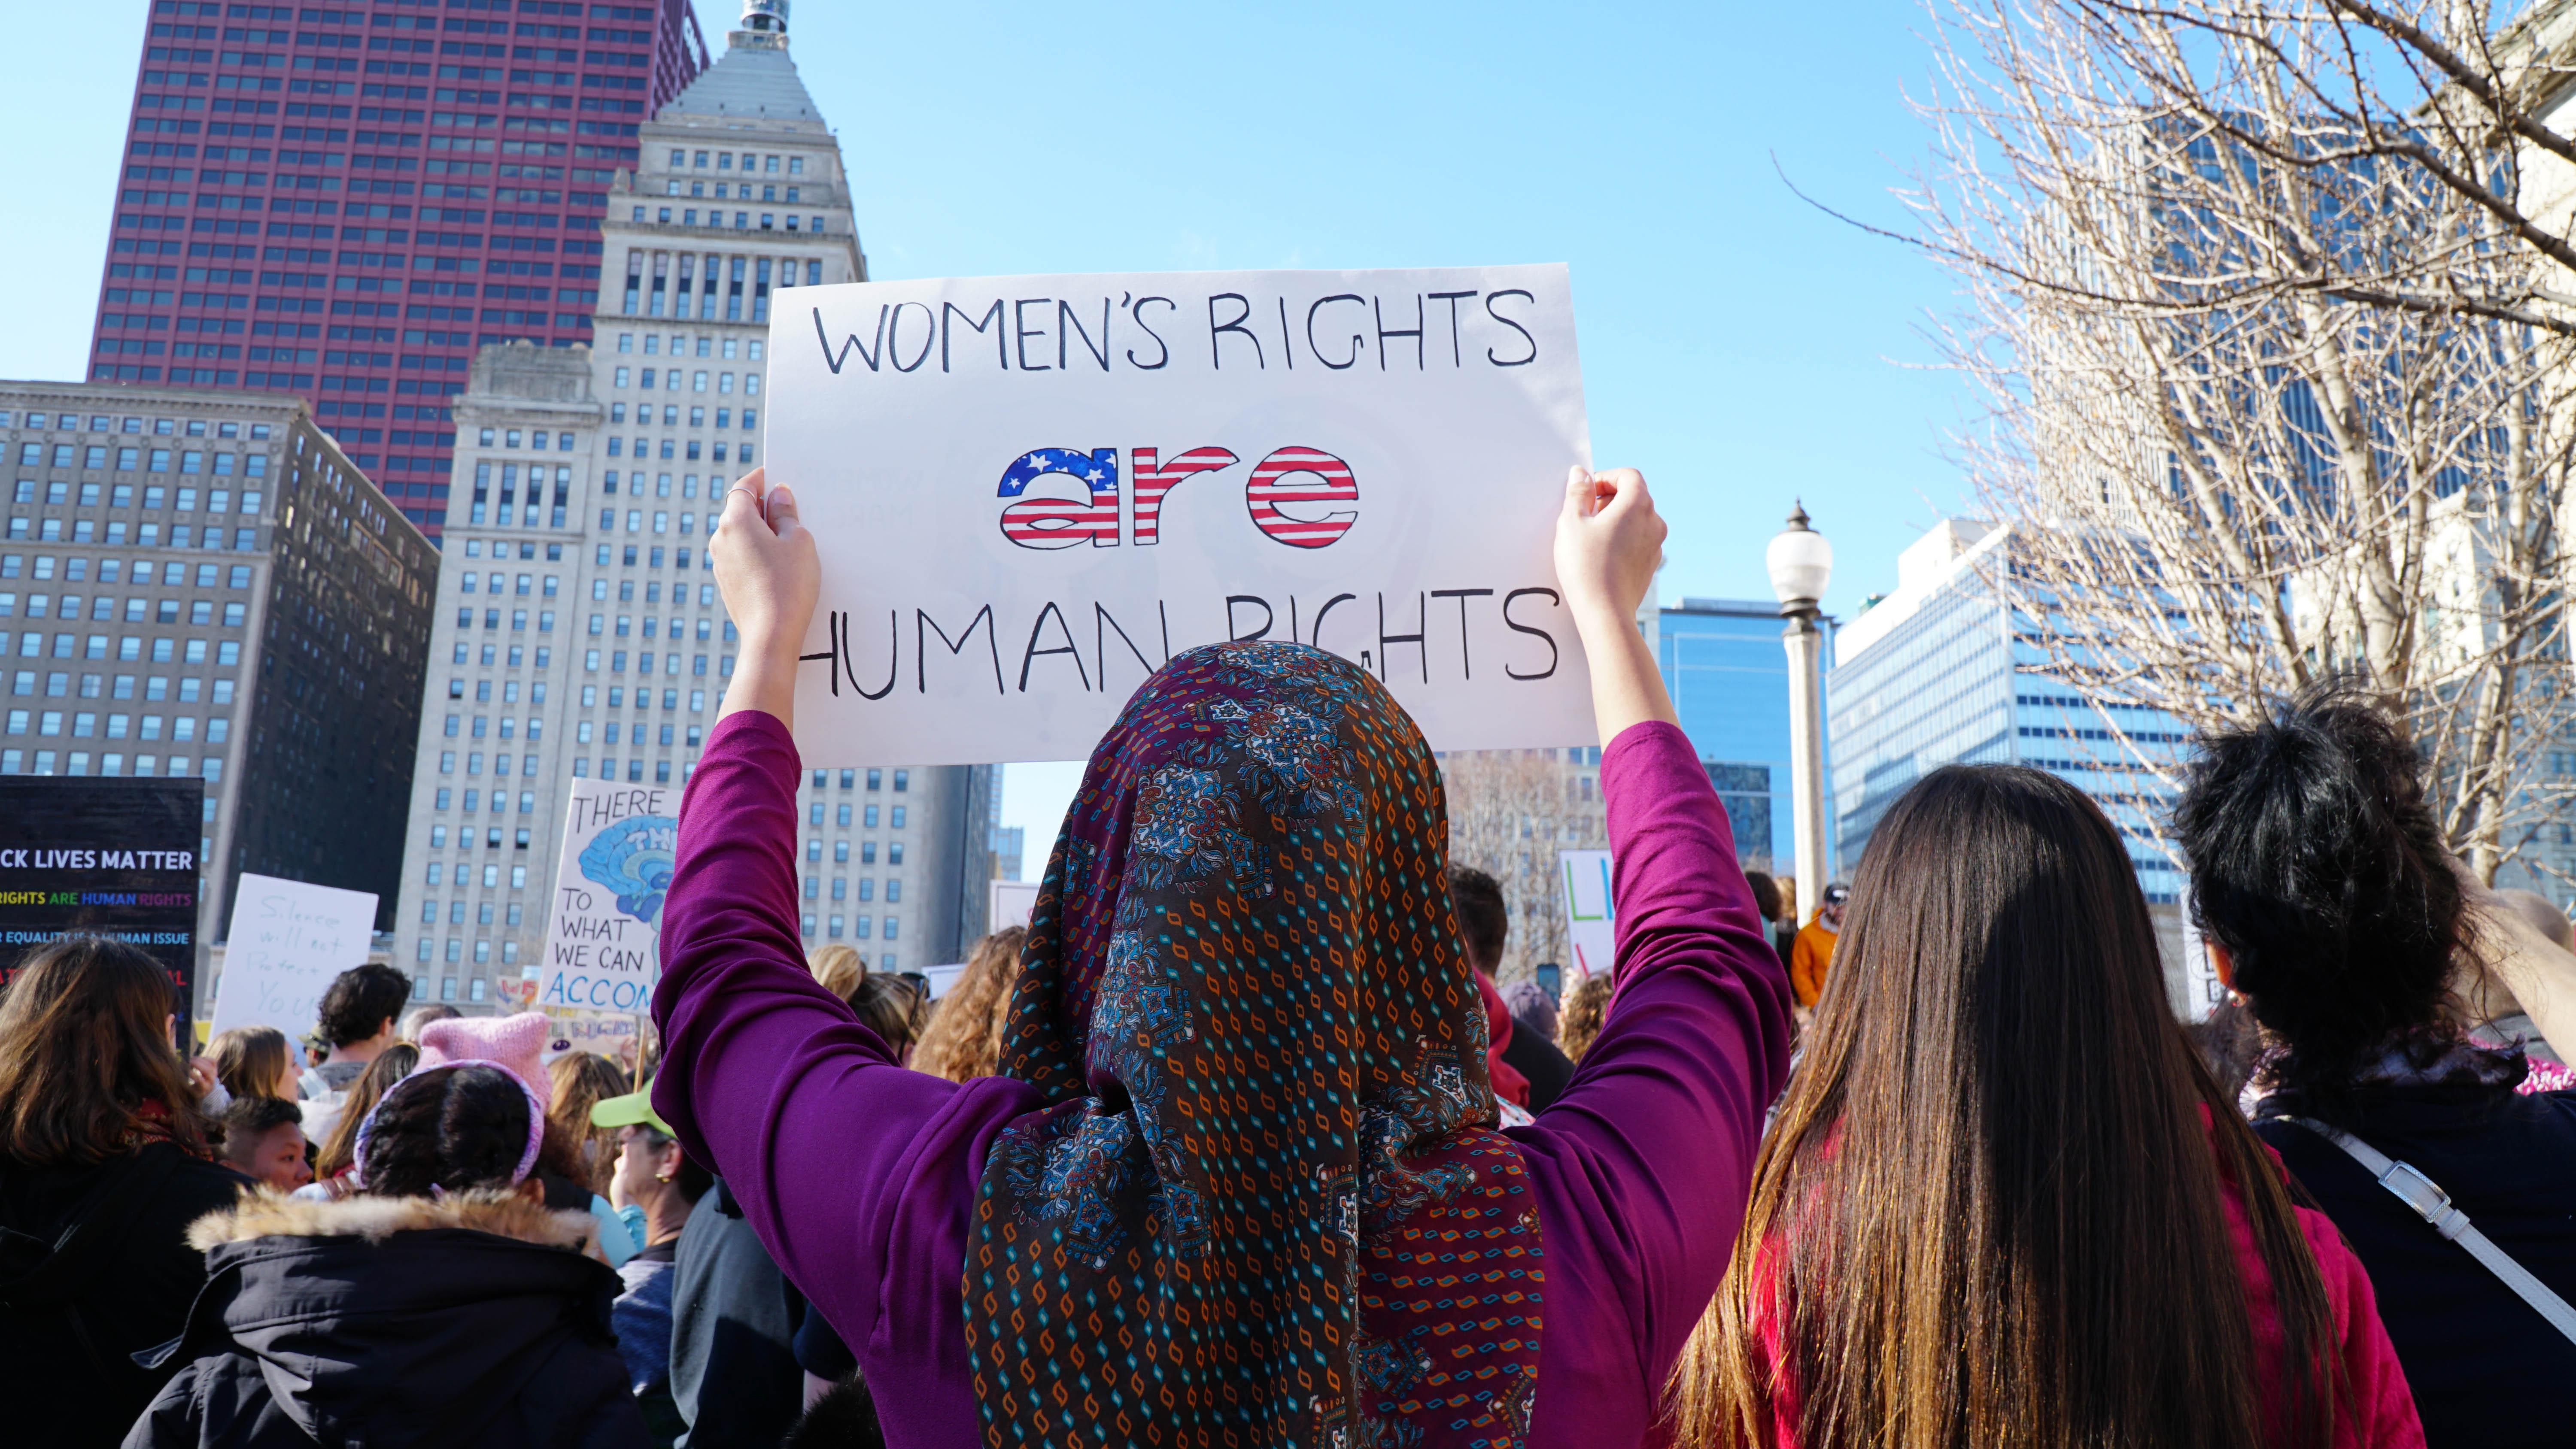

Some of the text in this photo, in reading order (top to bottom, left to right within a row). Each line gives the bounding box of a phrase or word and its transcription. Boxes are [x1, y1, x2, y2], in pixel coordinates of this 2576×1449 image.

[812, 289, 1537, 374] WOMEN'S RIGHTS
[996, 446, 1359, 551] are
[798, 600, 1170, 701] HUMAN
[573, 790, 665, 834] THERE
[35, 850, 96, 869] LIVES
[101, 851, 193, 870] MATTER
[49, 892, 79, 905] ARE
[82, 893, 137, 906] HUMAN
[139, 894, 192, 907] RIGHTS
[562, 887, 592, 912] TO
[6, 931, 70, 945] EQUALITY
[153, 933, 189, 945] ISSUE
[562, 915, 632, 942] WHAT
[555, 942, 644, 972] WE CAN
